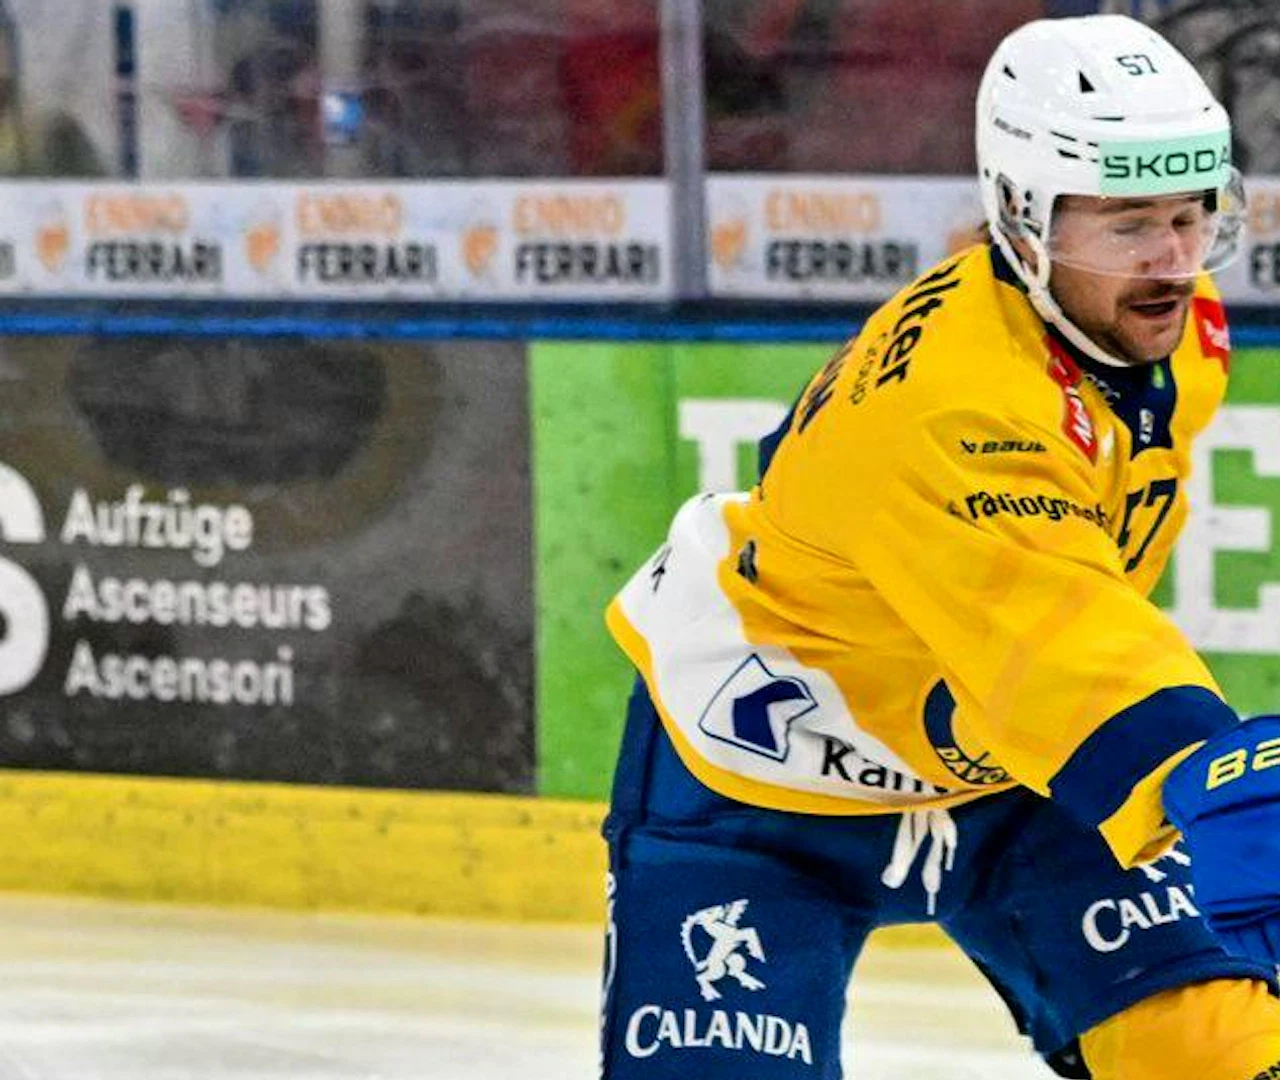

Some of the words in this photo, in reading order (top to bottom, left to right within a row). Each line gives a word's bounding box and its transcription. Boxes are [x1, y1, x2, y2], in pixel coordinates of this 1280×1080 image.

[1116, 53, 1159, 76] 57
[513, 192, 625, 235] ENNIO
[765, 188, 881, 235] ENNIO
[297, 243, 437, 282] FERRARI
[515, 240, 660, 283] FERRARI
[765, 238, 919, 281] FERRARI
[60, 483, 255, 567] Aufzüge
[62, 563, 332, 632] Ascenseurs
[64, 640, 294, 706] Ascensori
[1081, 884, 1202, 953] CALA
[625, 1004, 813, 1066] CALANDA
